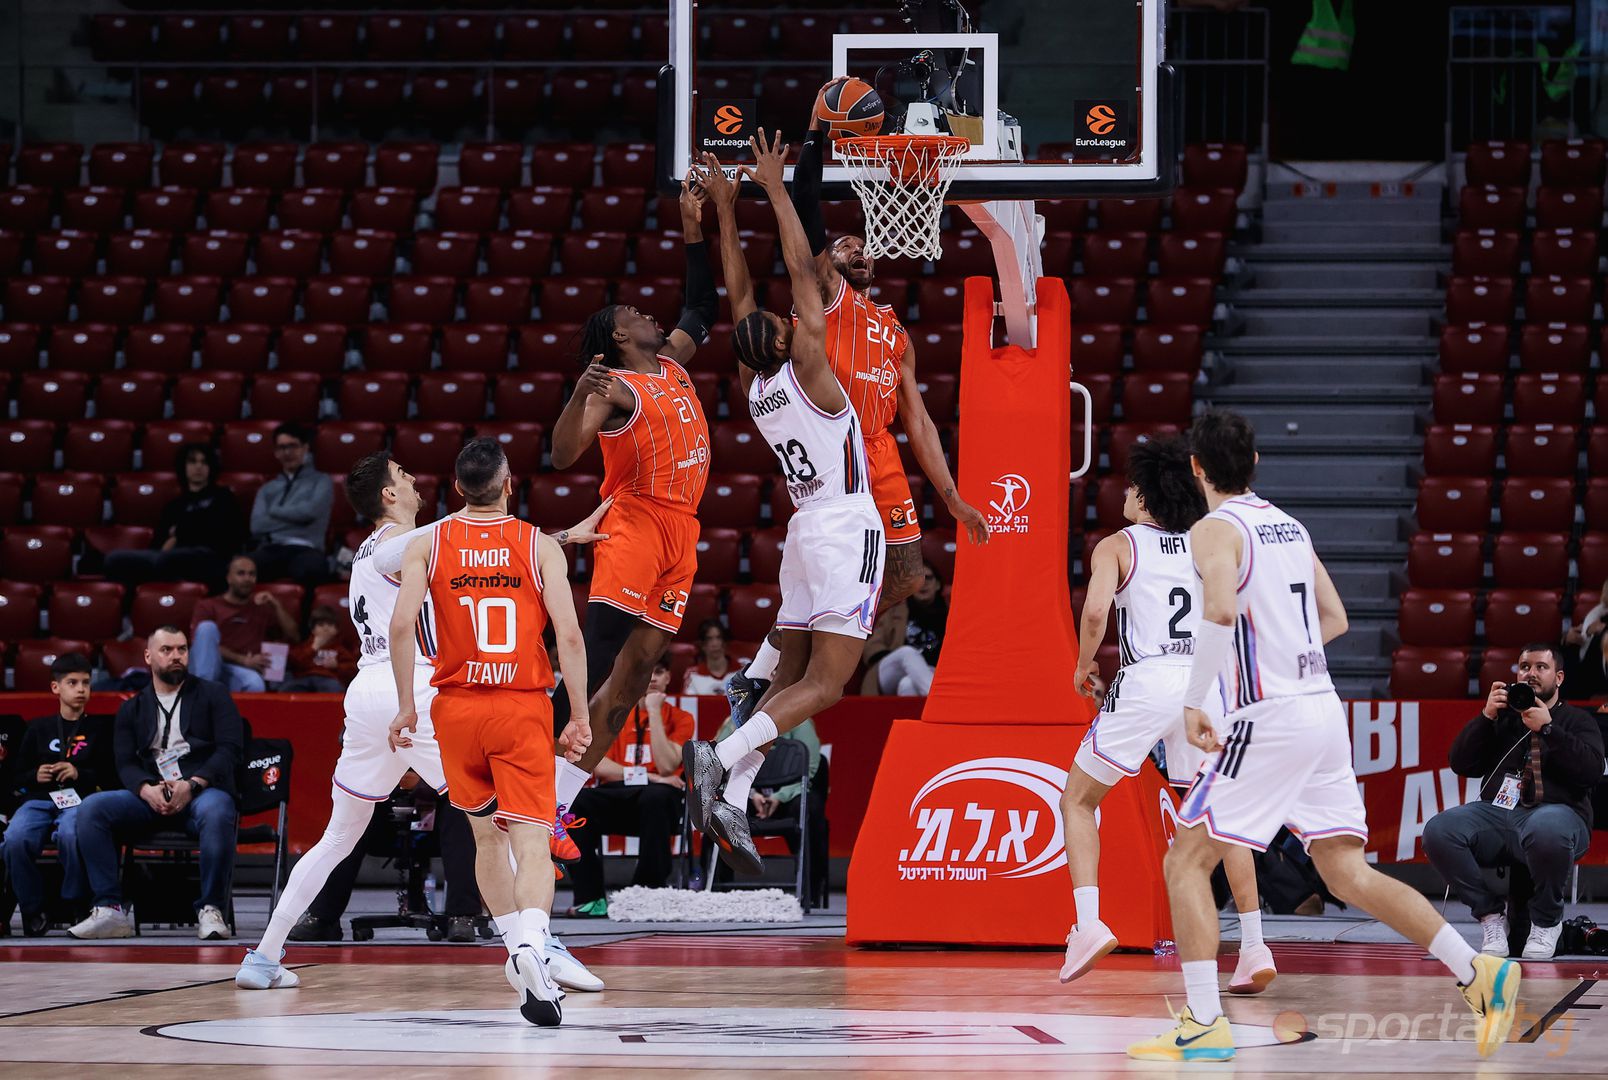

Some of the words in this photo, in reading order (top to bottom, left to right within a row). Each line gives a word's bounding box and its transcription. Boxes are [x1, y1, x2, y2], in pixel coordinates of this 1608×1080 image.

[703, 138, 751, 149] EuroLeague
[1075, 138, 1127, 149] EuroLeague
[866, 317, 896, 351] 24
[673, 396, 697, 423] 21
[774, 438, 817, 483] 13
[458, 547, 511, 568] TIMOR
[1159, 536, 1187, 555] HIFI
[353, 595, 370, 636] 4
[458, 595, 517, 654] 10
[1168, 586, 1192, 639] 2
[1289, 582, 1311, 645] 7
[480, 662, 519, 685] AVIV
[1342, 701, 1420, 777] BI
[248, 754, 281, 769] eague
[898, 864, 945, 881] ודיגיטל
[946, 864, 987, 881] חשמל
